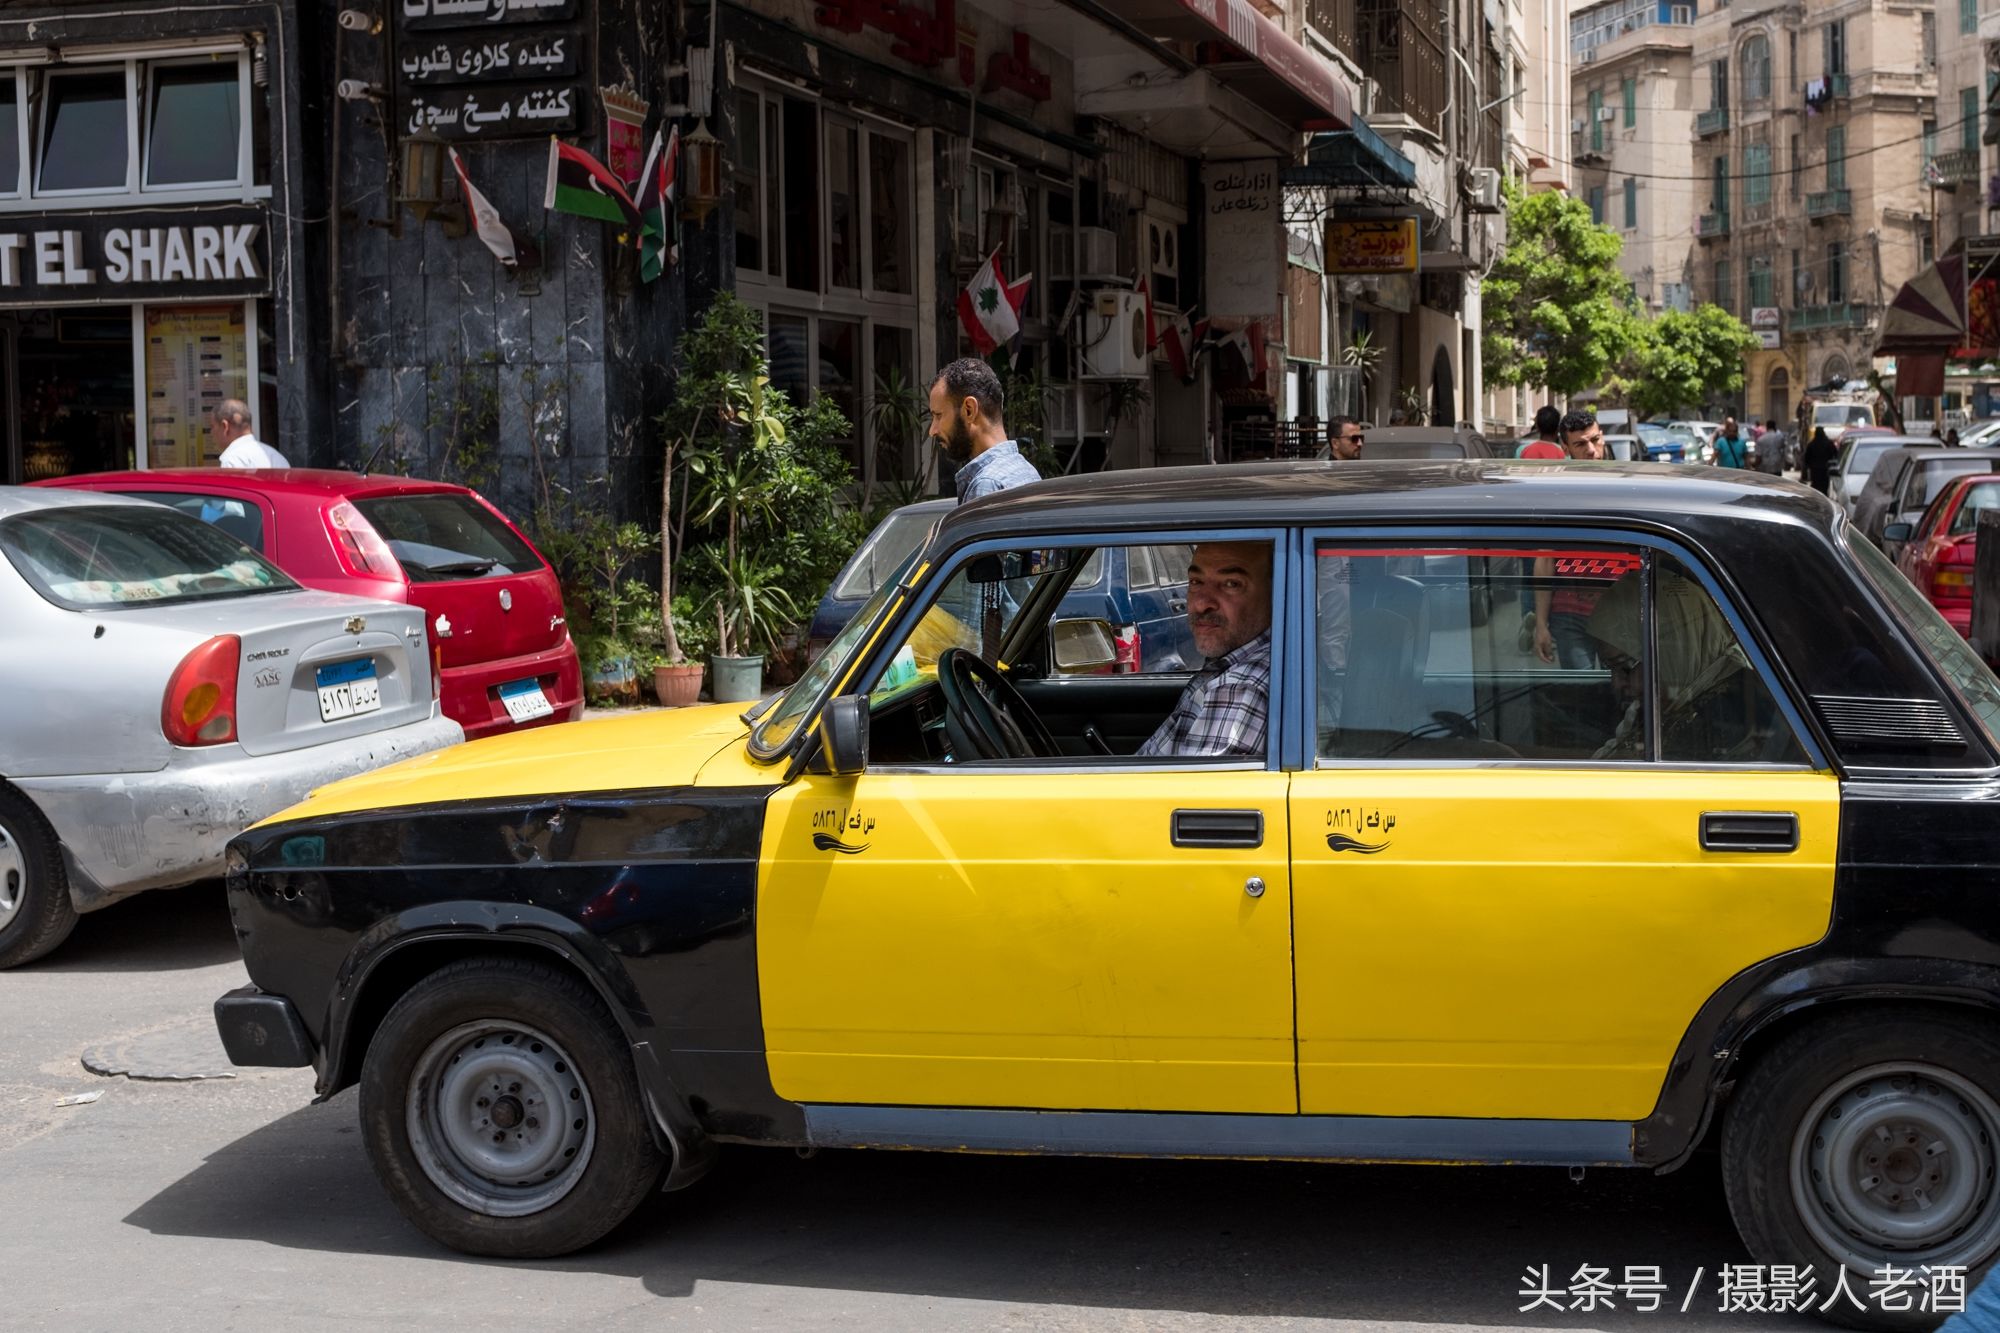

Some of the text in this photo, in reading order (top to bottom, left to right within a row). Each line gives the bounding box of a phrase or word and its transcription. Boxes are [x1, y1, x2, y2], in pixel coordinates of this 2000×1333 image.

[402, 44, 451, 80] قلوب
[518, 38, 565, 71] كبده
[408, 88, 570, 134] كفته مخ سجق
[34, 230, 96, 284] EL
[104, 224, 264, 283] SHARK
[813, 809, 836, 828] ٥٨٢٦
[1327, 808, 1352, 828] ٥٨٢٦
